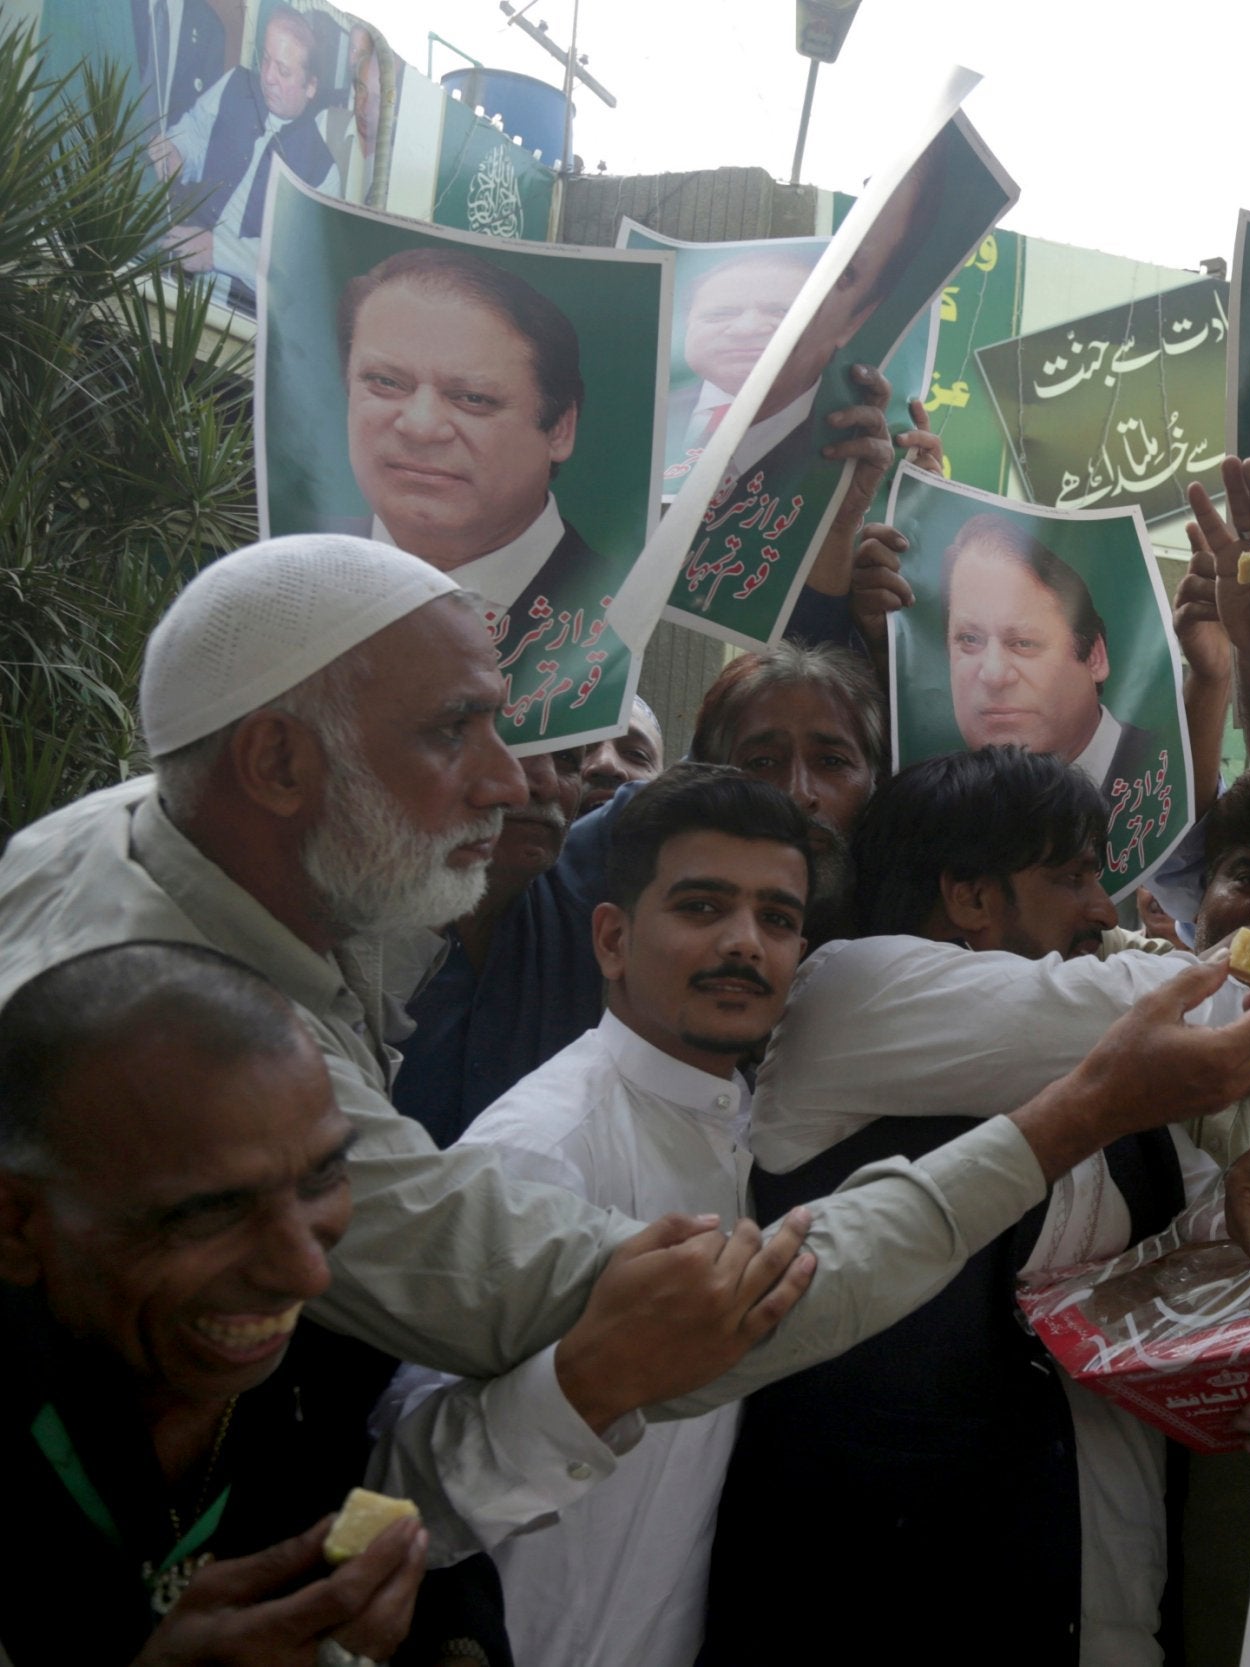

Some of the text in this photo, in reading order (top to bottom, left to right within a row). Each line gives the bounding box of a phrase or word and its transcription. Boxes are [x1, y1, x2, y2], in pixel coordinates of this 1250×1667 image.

[1111, 335, 1162, 373] سے
[740, 494, 804, 540] نواز
[702, 545, 780, 613] قوم
[539, 650, 608, 736] قوم
[1130, 750, 1168, 813] نواز
[1138, 785, 1172, 869] قوم
